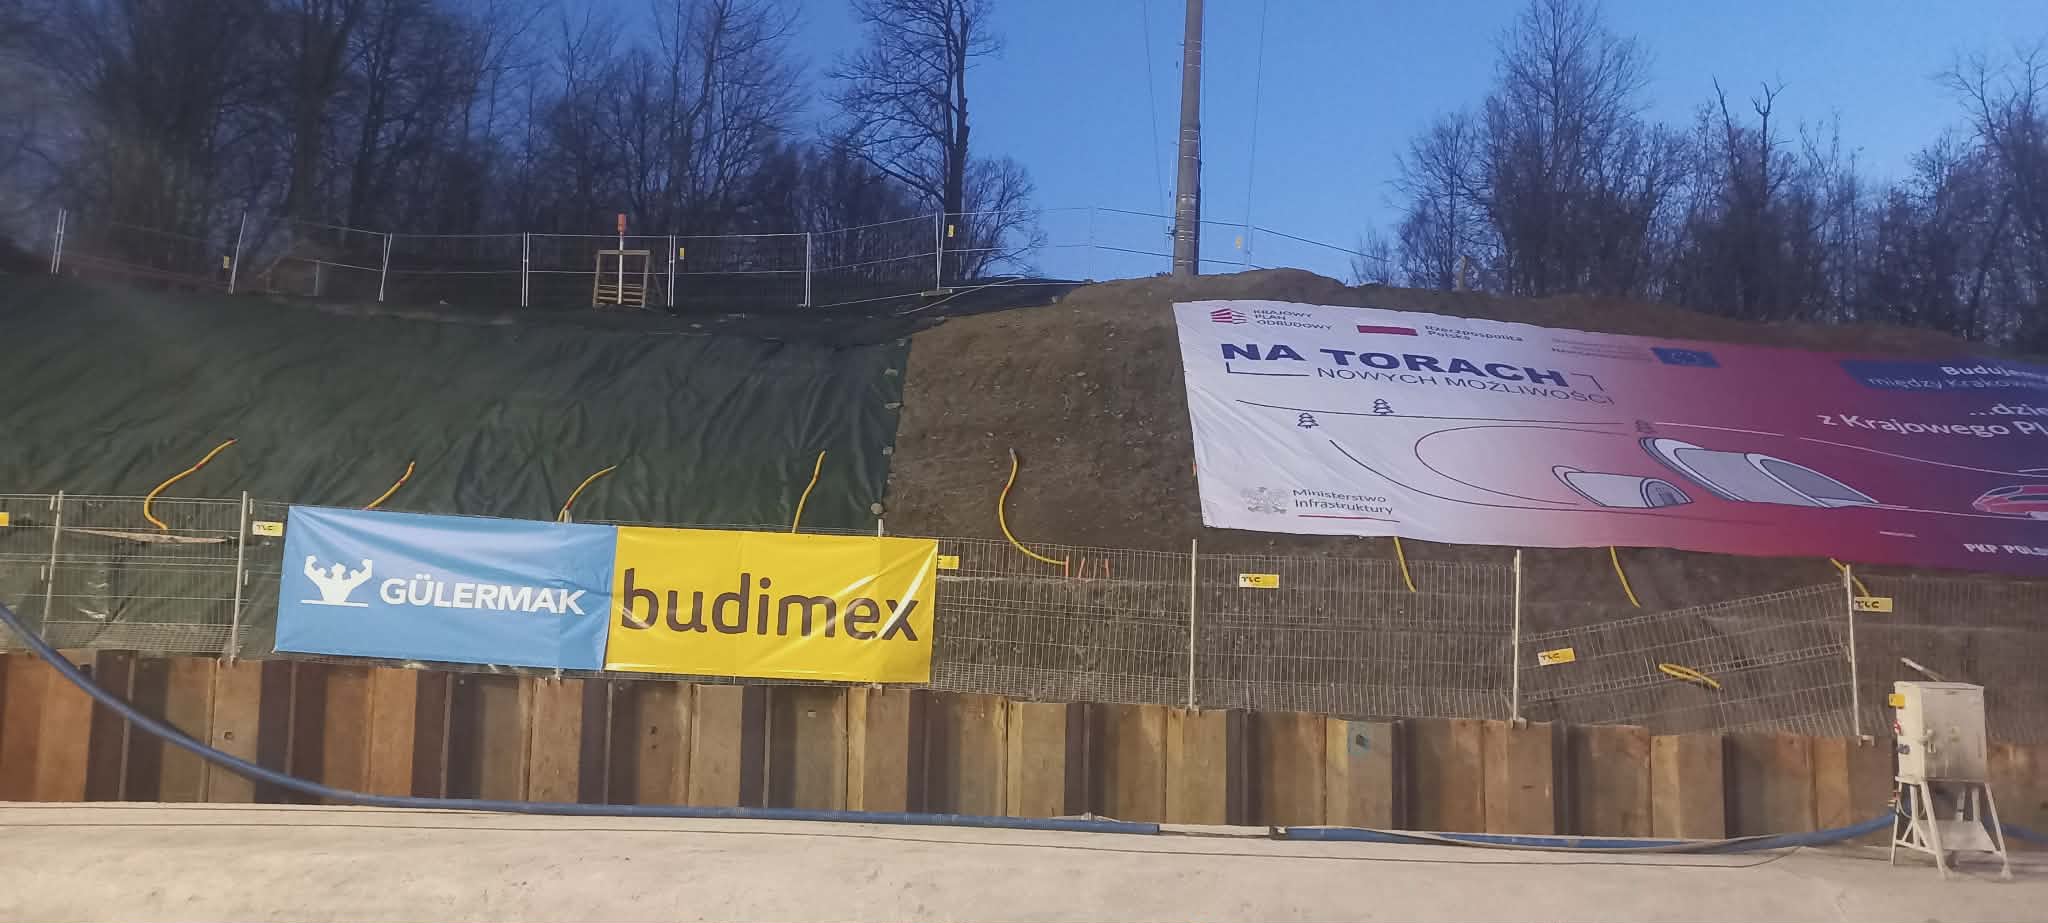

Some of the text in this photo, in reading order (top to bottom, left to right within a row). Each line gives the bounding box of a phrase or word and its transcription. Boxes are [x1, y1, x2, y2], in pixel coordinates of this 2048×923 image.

[1221, 343, 1307, 361] NA
[1319, 348, 1568, 388] TORACH
[1317, 367, 1437, 385] NOWYCH
[1816, 414, 1838, 426] z
[1840, 414, 2010, 438] Krajowego
[1293, 488, 1387, 503] Ministerstwo
[1295, 498, 1393, 515] Infrastruktury
[1963, 543, 1998, 553] PKP
[379, 573, 587, 616] GÜLERMAK
[621, 567, 919, 642] budimex
